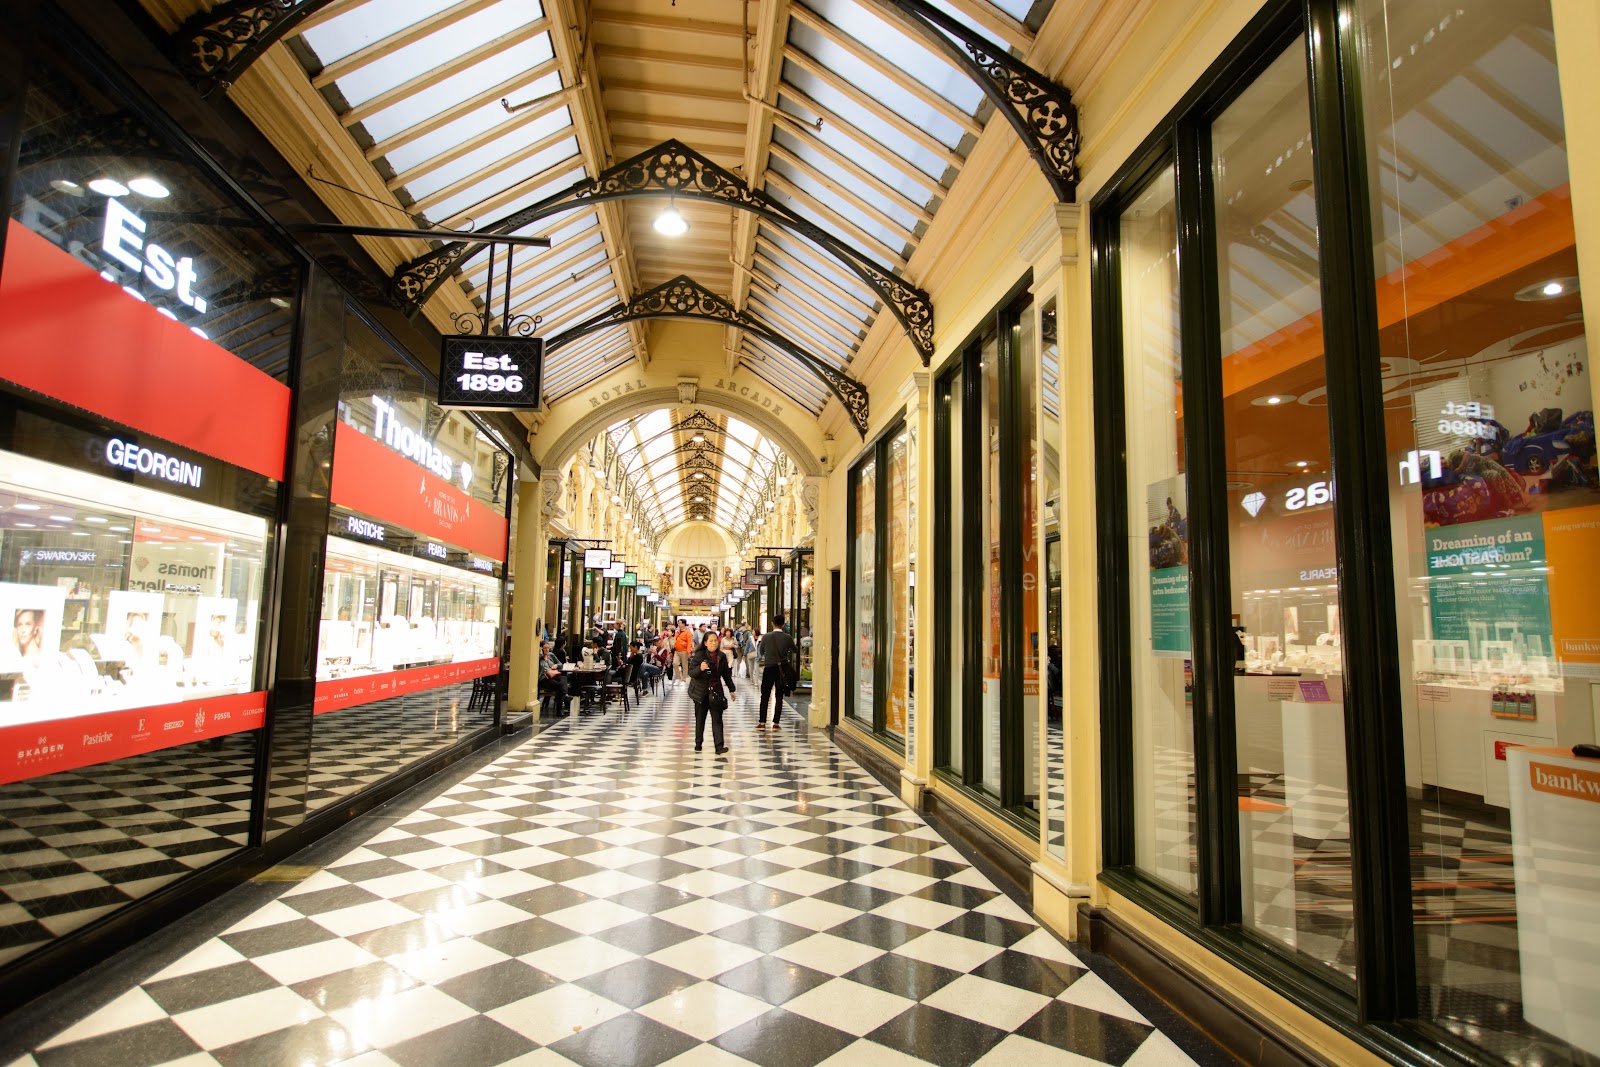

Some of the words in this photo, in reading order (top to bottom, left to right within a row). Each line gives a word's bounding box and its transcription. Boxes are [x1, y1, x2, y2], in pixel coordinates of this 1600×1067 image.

[102, 197, 207, 314] Est.
[463, 351, 519, 371] Est.
[456, 373, 523, 392] 1896
[588, 379, 647, 408] ROYAL
[715, 379, 784, 416] ARCADE
[371, 394, 453, 481] Thomas
[106, 438, 202, 488] GEORGINI
[433, 497, 459, 524] BRANDS
[347, 516, 385, 541] PASTICHE
[428, 542, 447, 559] PEARLS
[1432, 534, 1496, 552] Dreaming
[1497, 530, 1512, 544] of
[1514, 531, 1533, 543] an
[37, 550, 96, 562] SWAROVSKI
[1152, 576, 1175, 585] Dreaming
[214, 711, 232, 721] FOSSIL
[82, 731, 113, 746] Pastiche
[17, 743, 64, 759] SKAGEN
